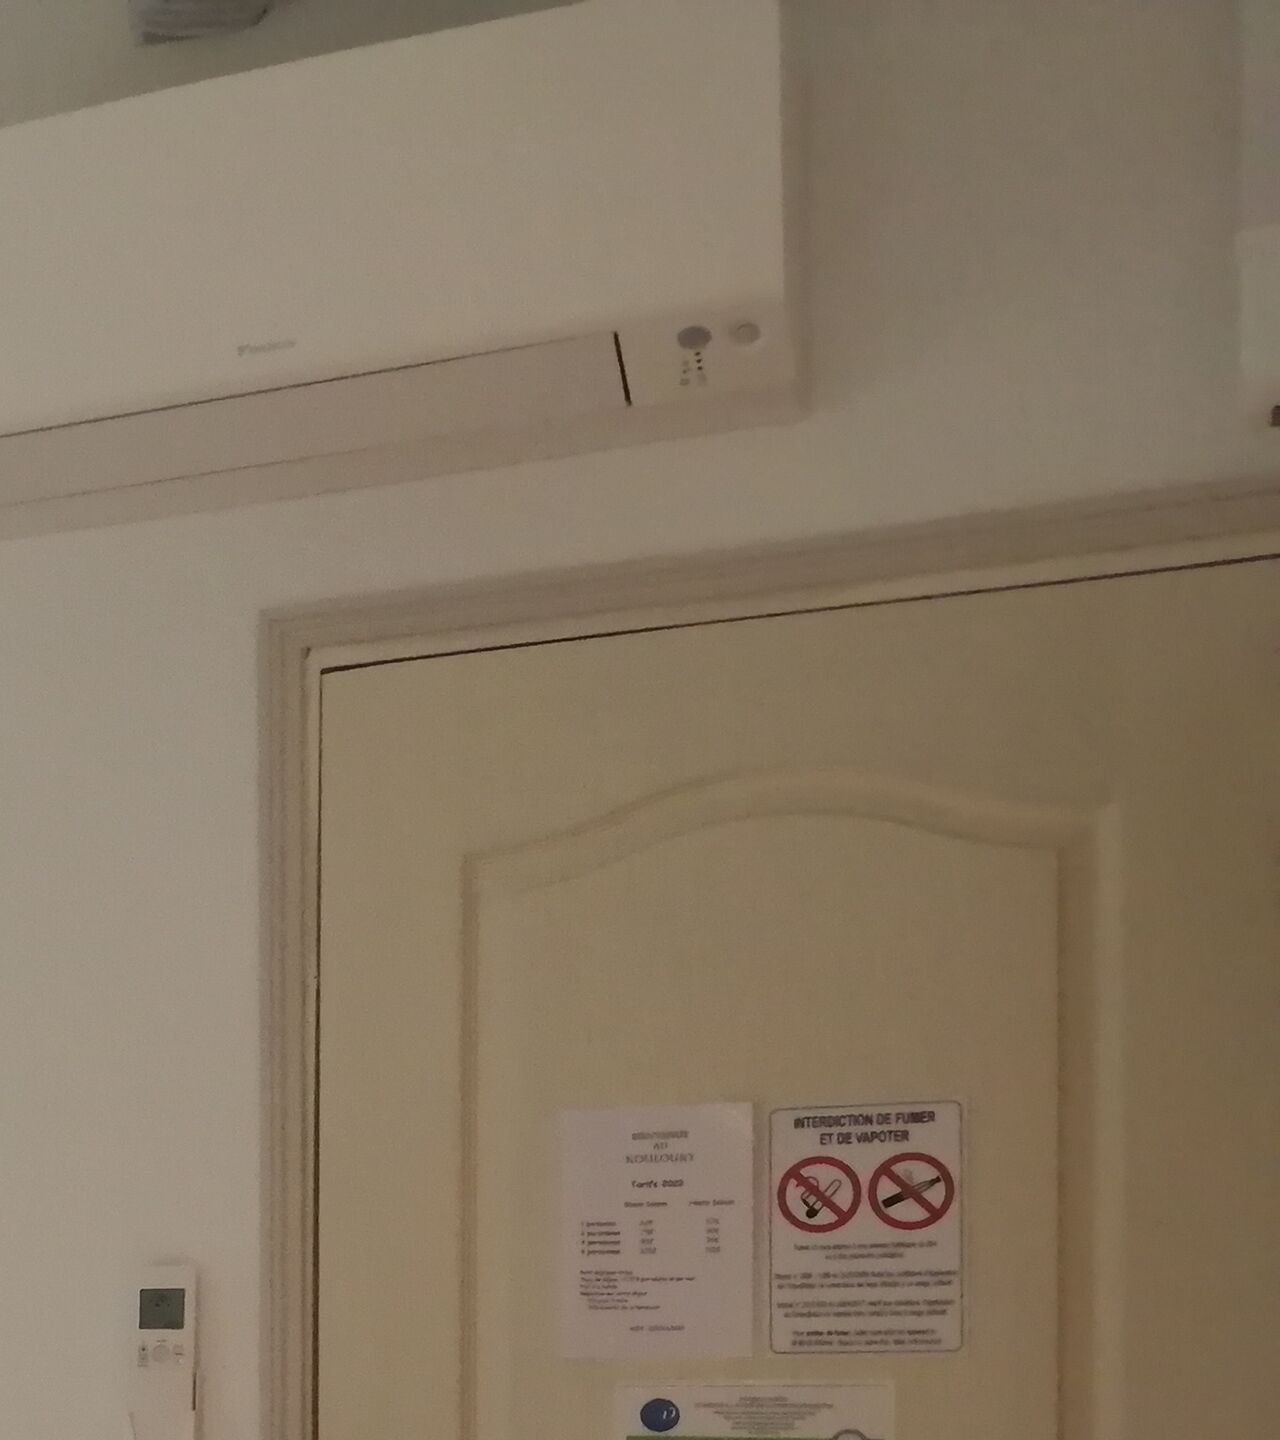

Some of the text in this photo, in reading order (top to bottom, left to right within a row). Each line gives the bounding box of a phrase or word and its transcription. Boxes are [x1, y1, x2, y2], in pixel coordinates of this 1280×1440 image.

[793, 1110, 936, 1129] INTERDICTION DE FUMER
[819, 1130, 910, 1145] ET DE VAPOTER
